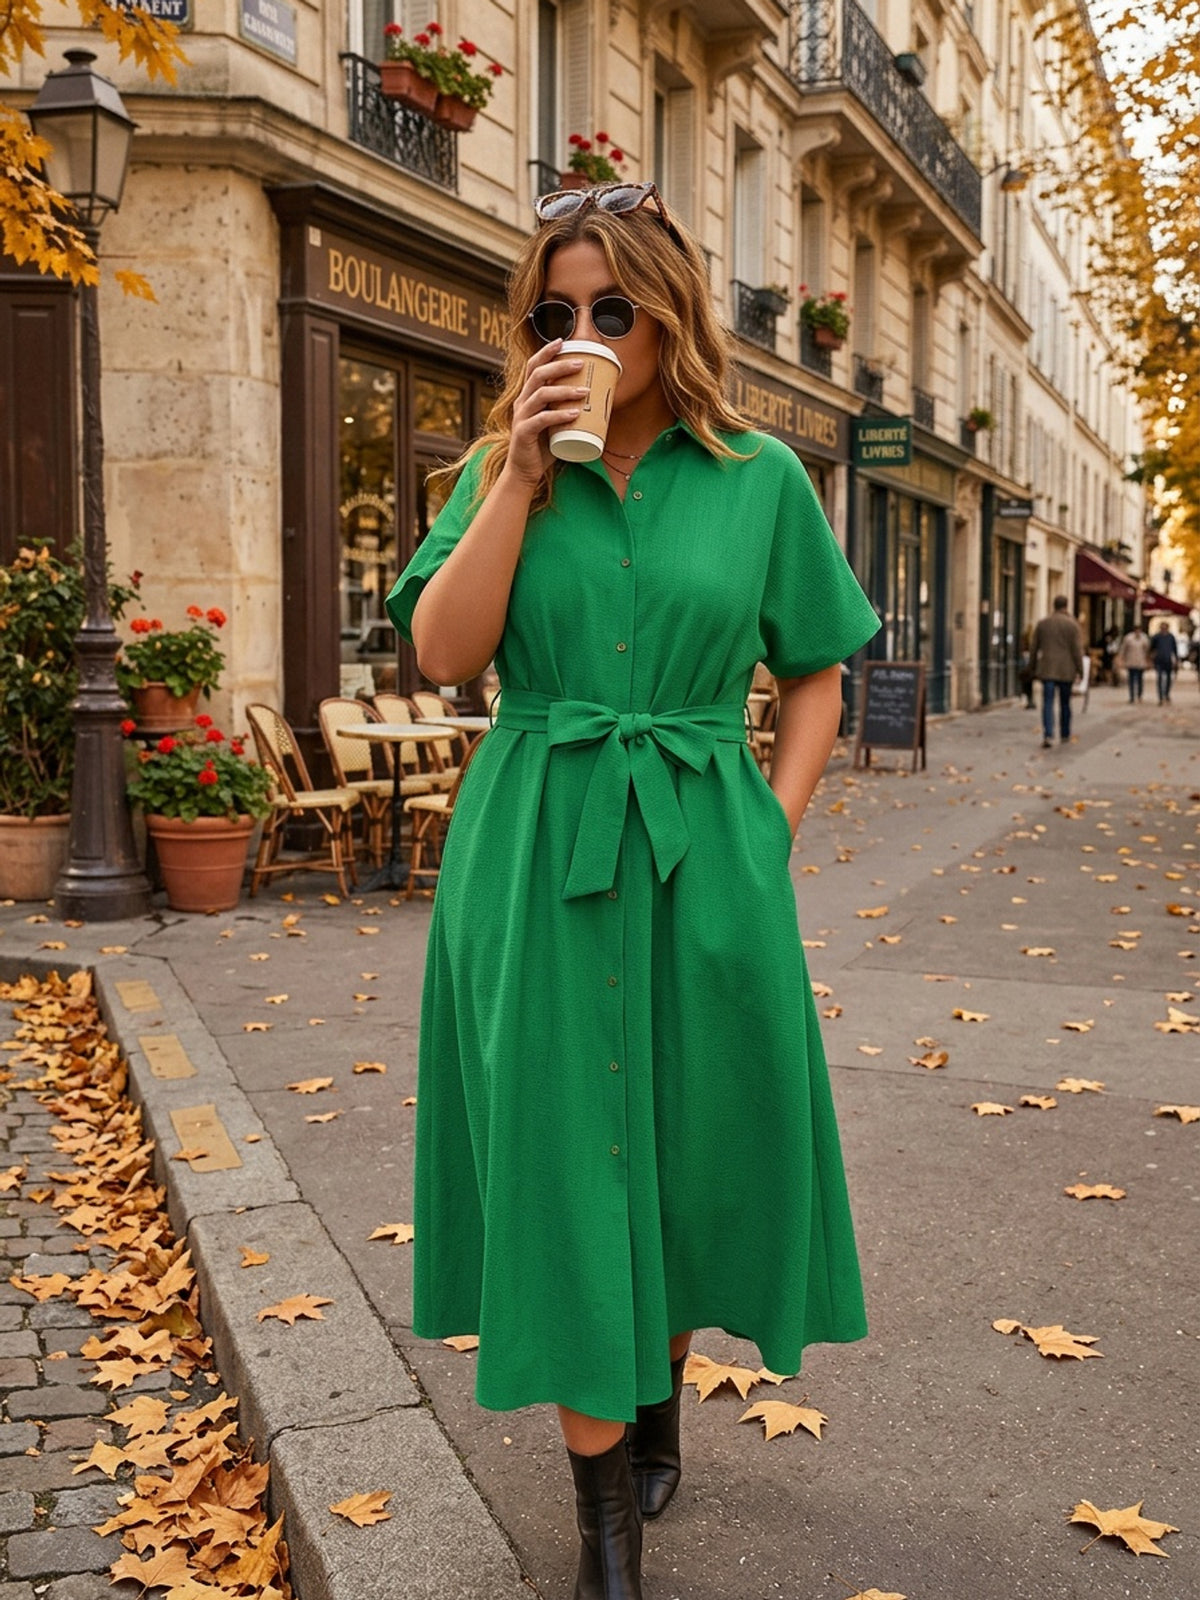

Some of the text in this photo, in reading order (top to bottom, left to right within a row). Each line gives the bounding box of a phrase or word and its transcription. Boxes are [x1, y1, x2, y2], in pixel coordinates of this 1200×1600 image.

[329, 249, 468, 336] BOULANGERIE
[736, 379, 837, 449] LIBERTÉ LIVRES
